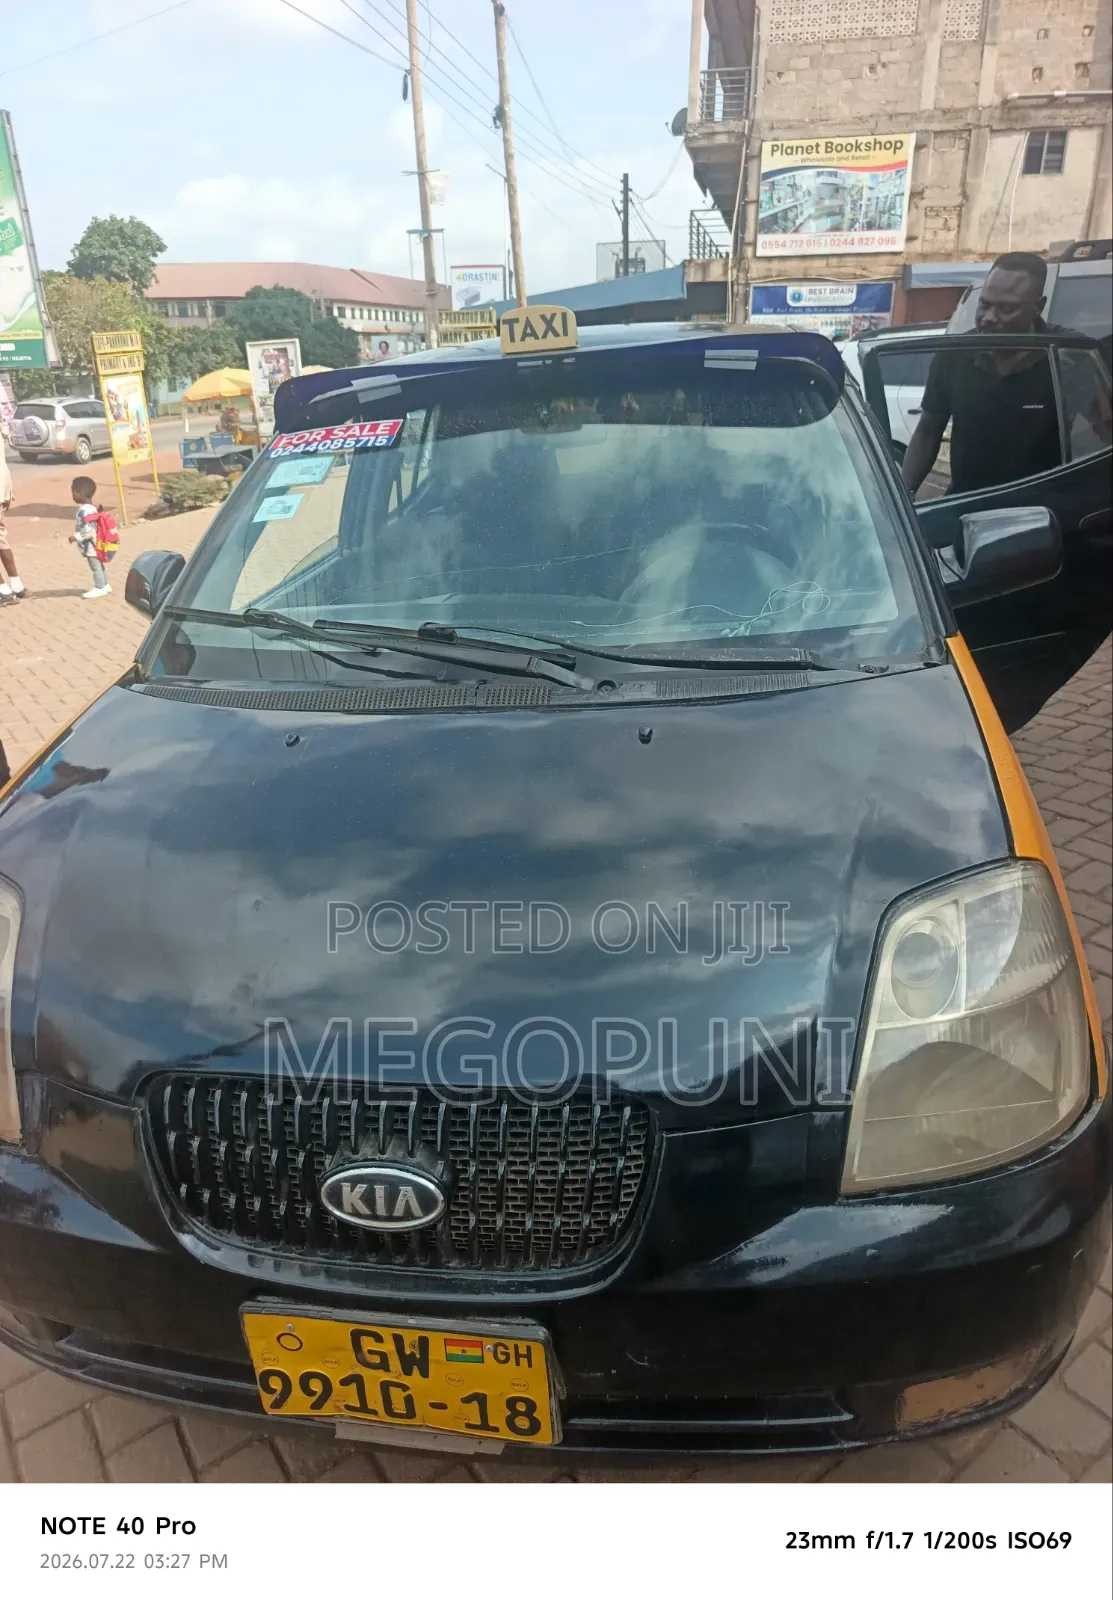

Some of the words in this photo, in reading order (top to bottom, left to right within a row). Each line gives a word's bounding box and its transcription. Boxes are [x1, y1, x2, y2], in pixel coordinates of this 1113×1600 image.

[770, 141, 820, 157] Planet
[824, 138, 904, 155] Bookshop
[800, 156, 835, 164] Wholesale
[836, 155, 850, 163] and
[789, 238, 804, 248] 712
[829, 237, 855, 248] 0244
[808, 288, 827, 296] BEST
[829, 287, 854, 295] BRAIN
[502, 312, 568, 343] TAXI
[269, 435, 389, 458] 0244085715
[278, 430, 327, 447] FOR
[330, 422, 395, 439] SALE
[341, 1182, 424, 1217] KIA
[350, 1328, 429, 1379] GW
[493, 1341, 533, 1368] GH
